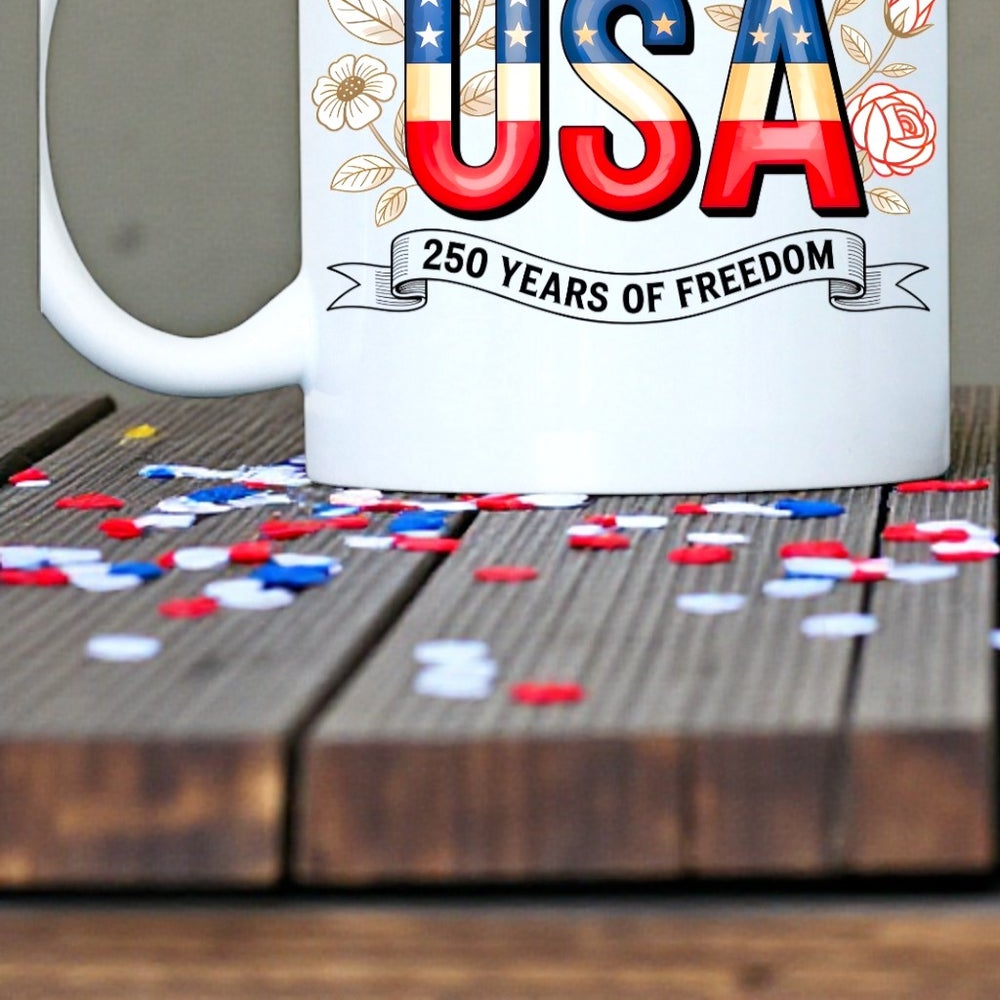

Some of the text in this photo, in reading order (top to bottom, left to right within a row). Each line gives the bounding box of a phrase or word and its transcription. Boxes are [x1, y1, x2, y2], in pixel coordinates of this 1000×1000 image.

[422, 238, 835, 314] 250 YEARS OF FREEDOM
